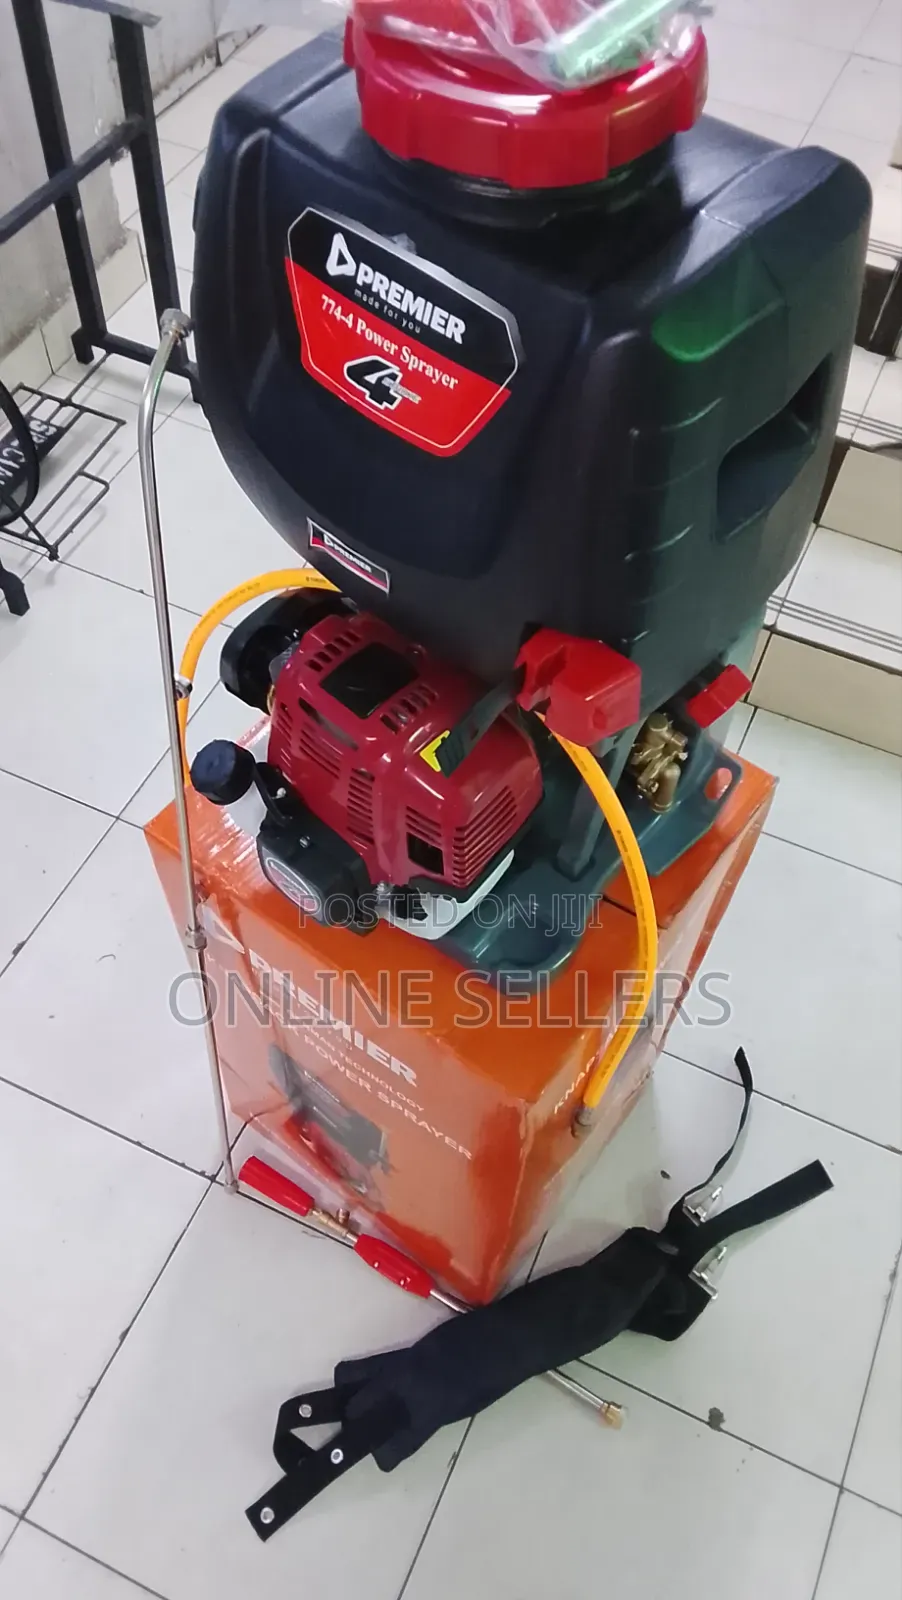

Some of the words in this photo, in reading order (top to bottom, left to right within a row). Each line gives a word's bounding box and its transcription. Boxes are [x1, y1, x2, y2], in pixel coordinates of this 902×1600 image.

[322, 294, 353, 329] 774-4
[356, 318, 398, 355] Power
[400, 345, 459, 390] Sprayer
[354, 287, 380, 310] made
[383, 305, 398, 321] for
[402, 316, 421, 335] you
[356, 262, 466, 345] PREMIER
[249, 948, 417, 1087] PREMIER
[304, 1034, 372, 1092] POWER
[377, 1091, 472, 1160] SPRAYER
[338, 1050, 425, 1111] TECHNOLOGY
